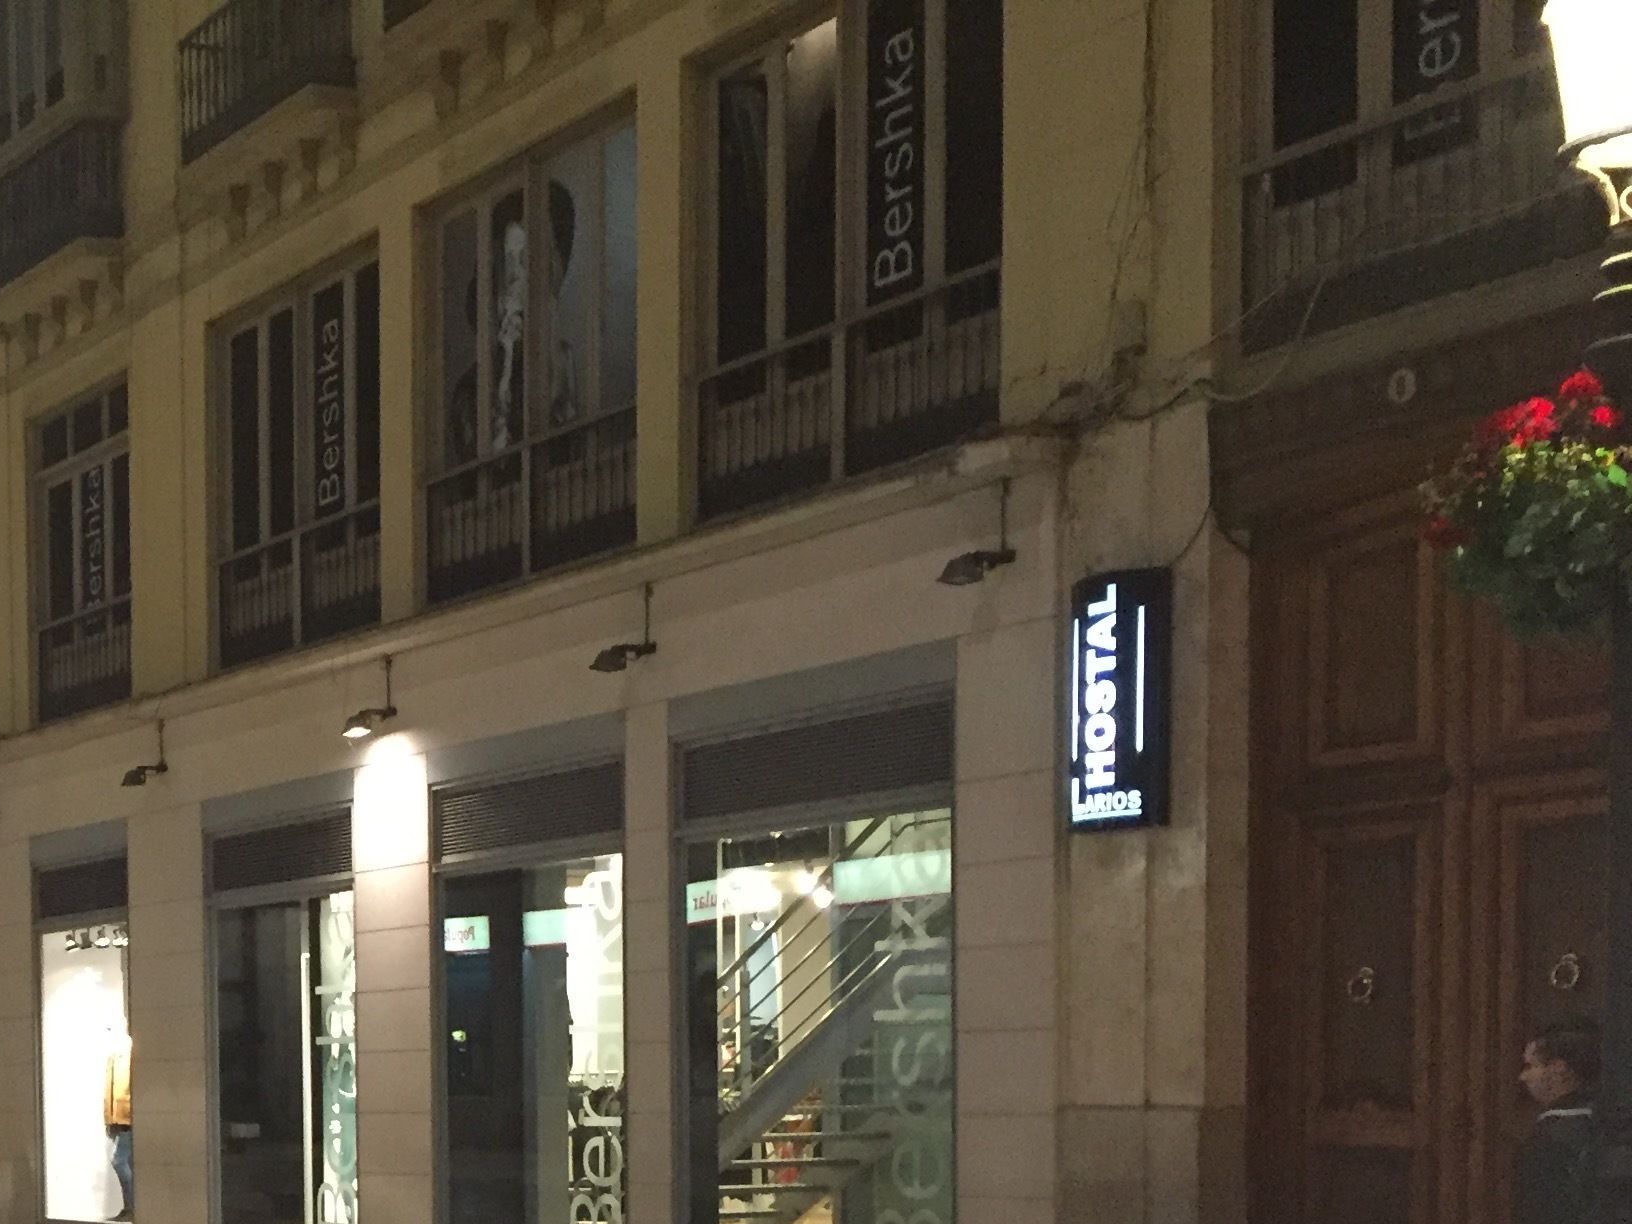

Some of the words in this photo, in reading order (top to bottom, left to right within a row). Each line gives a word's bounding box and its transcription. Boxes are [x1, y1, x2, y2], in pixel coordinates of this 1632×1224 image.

[874, 27, 915, 288] Bershka
[318, 318, 340, 506] Bershka
[1084, 583, 1117, 790] HOSTAL
[1071, 777, 1143, 817] LARIOS
